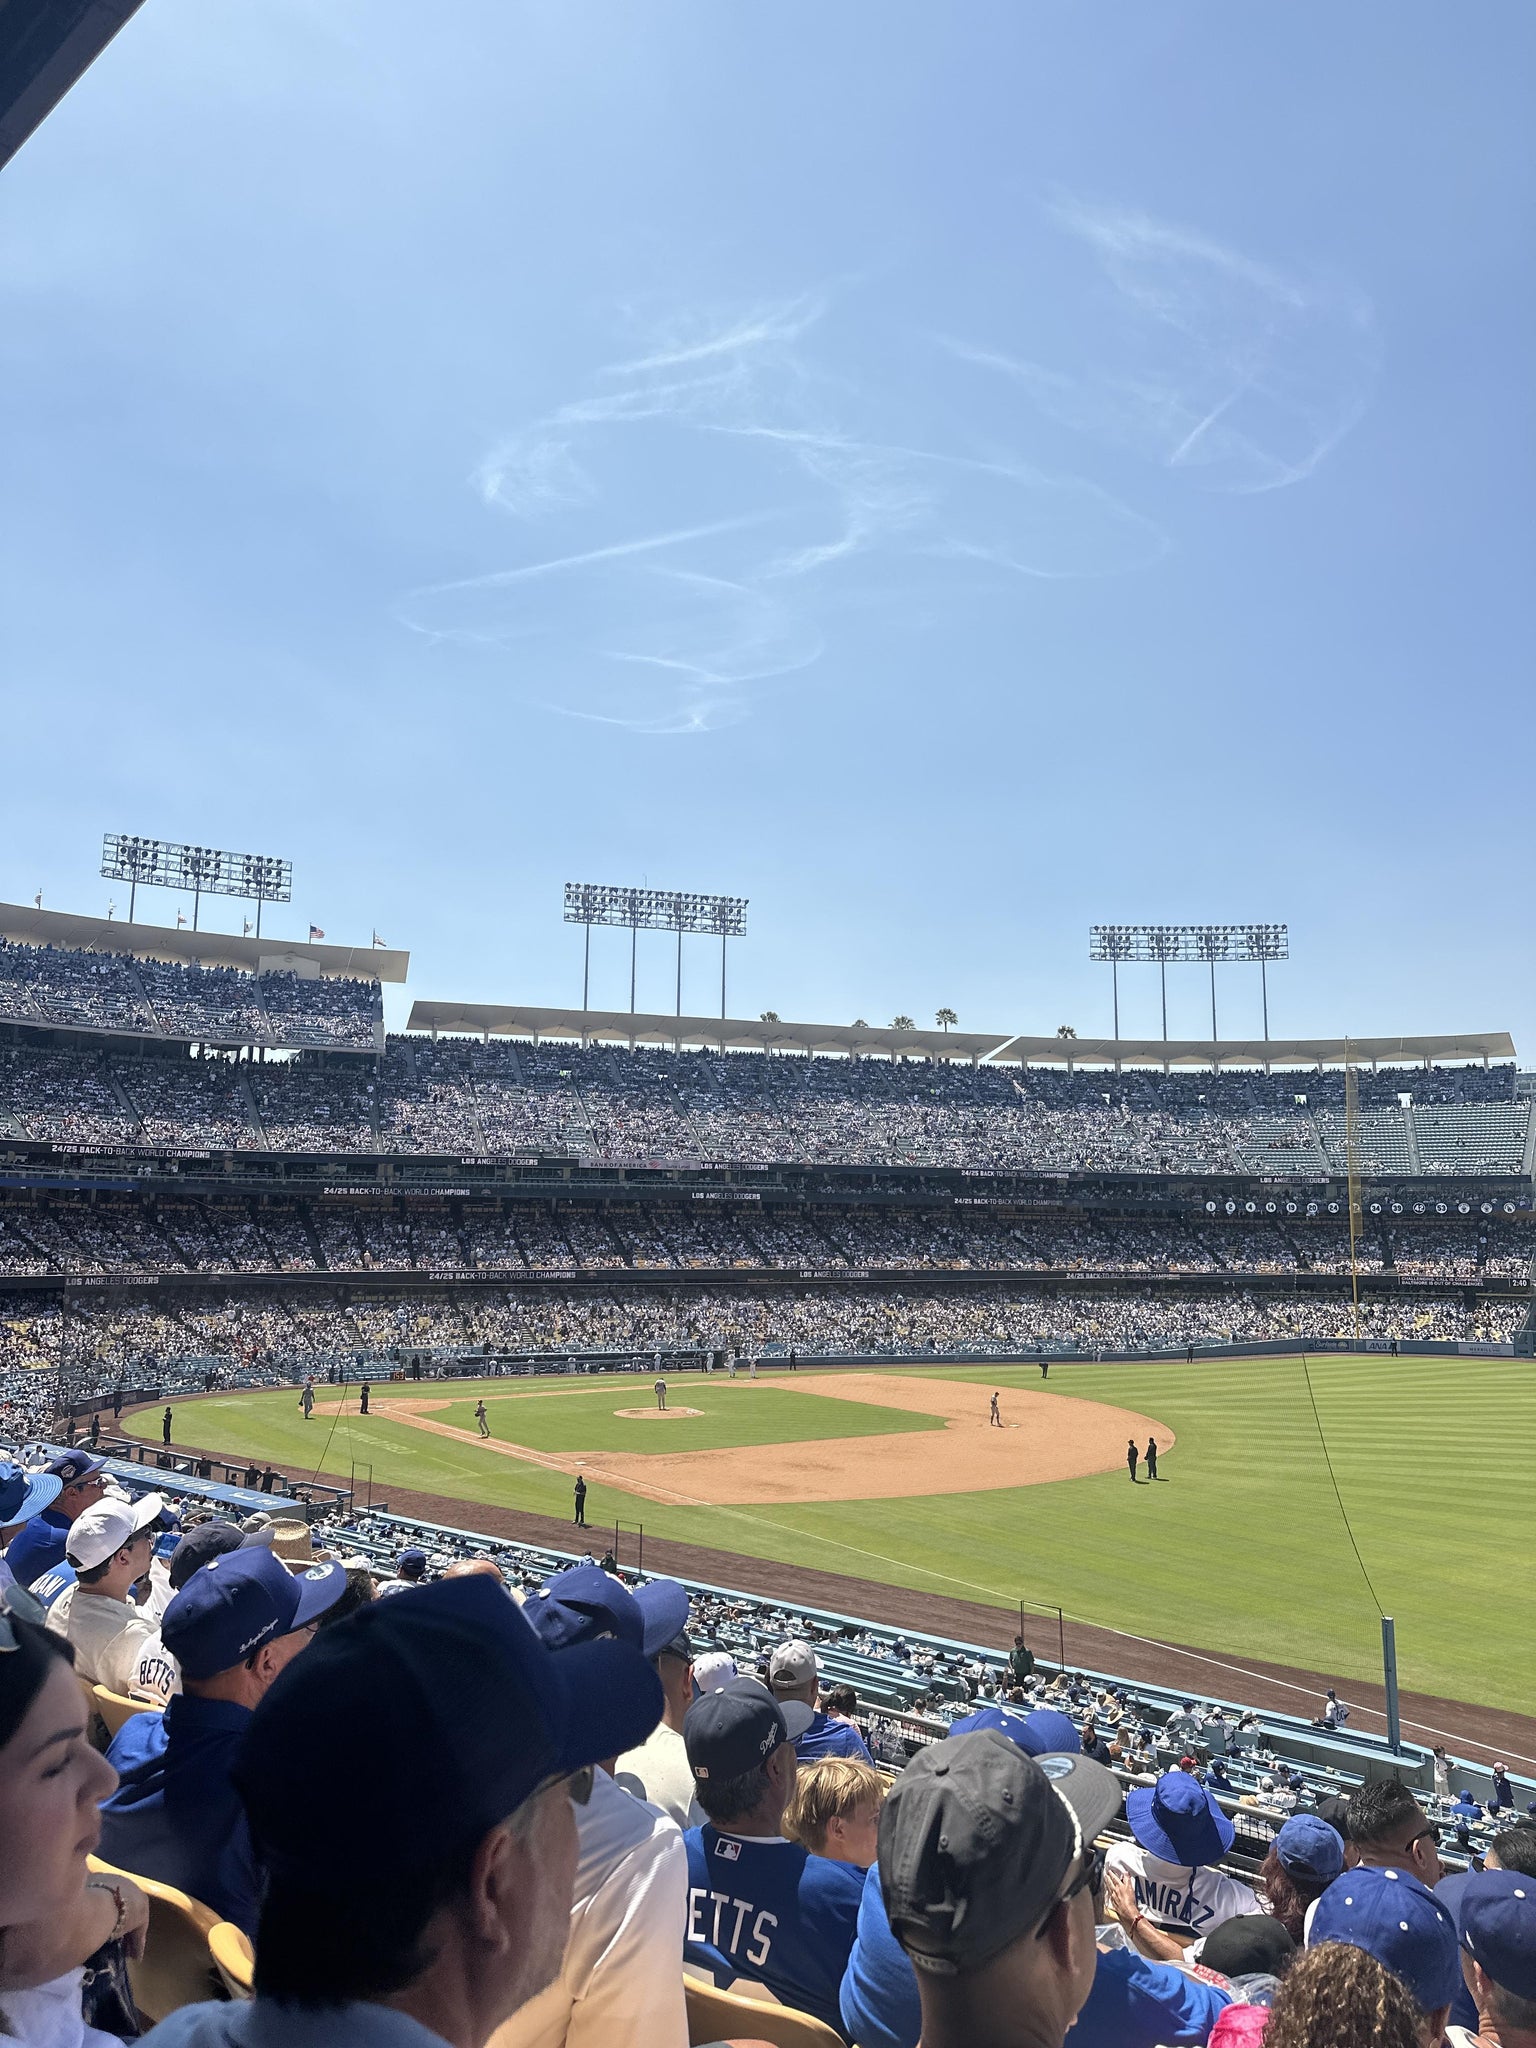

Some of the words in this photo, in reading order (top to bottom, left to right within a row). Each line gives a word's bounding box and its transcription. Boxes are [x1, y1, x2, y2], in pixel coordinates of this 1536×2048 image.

[52, 1144, 77, 1153] 24/25
[79, 1146, 135, 1156] BACK-TO-BACK
[137, 1149, 164, 1157] WORLD
[166, 1150, 210, 1159] CHAMPIONS
[461, 1157, 475, 1165] LOS
[477, 1158, 507, 1166] ANGELES
[508, 1158, 539, 1166] DODGERS
[980, 1170, 1019, 1178] BACK-TO-BACK
[323, 1187, 348, 1195] 24/25
[349, 1187, 402, 1196] BACK-TO-BACK
[404, 1188, 429, 1196] WORLD
[430, 1188, 471, 1196] CHAMPIONS
[1414, 1204, 1424, 1212] 42
[429, 1272, 453, 1280] 24/25
[455, 1272, 507, 1280] BACK-TO-BACK
[509, 1271, 534, 1279] WORLD
[535, 1271, 576, 1279] CHAMPIONS
[66, 1277, 82, 1286] LOS
[84, 1277, 120, 1285] ANGELES
[122, 1276, 159, 1285] DODGERS
[1512, 1279, 1528, 1287] 2:40
[1368, 1342, 1387, 1350] ANA
[136, 1470, 220, 1492] STADIUM
[139, 1658, 175, 1696] BETTS
[760, 1721, 778, 1755] Dodgers
[1134, 1874, 1216, 1929] AMIREZ
[686, 1887, 779, 1967] ETTS
